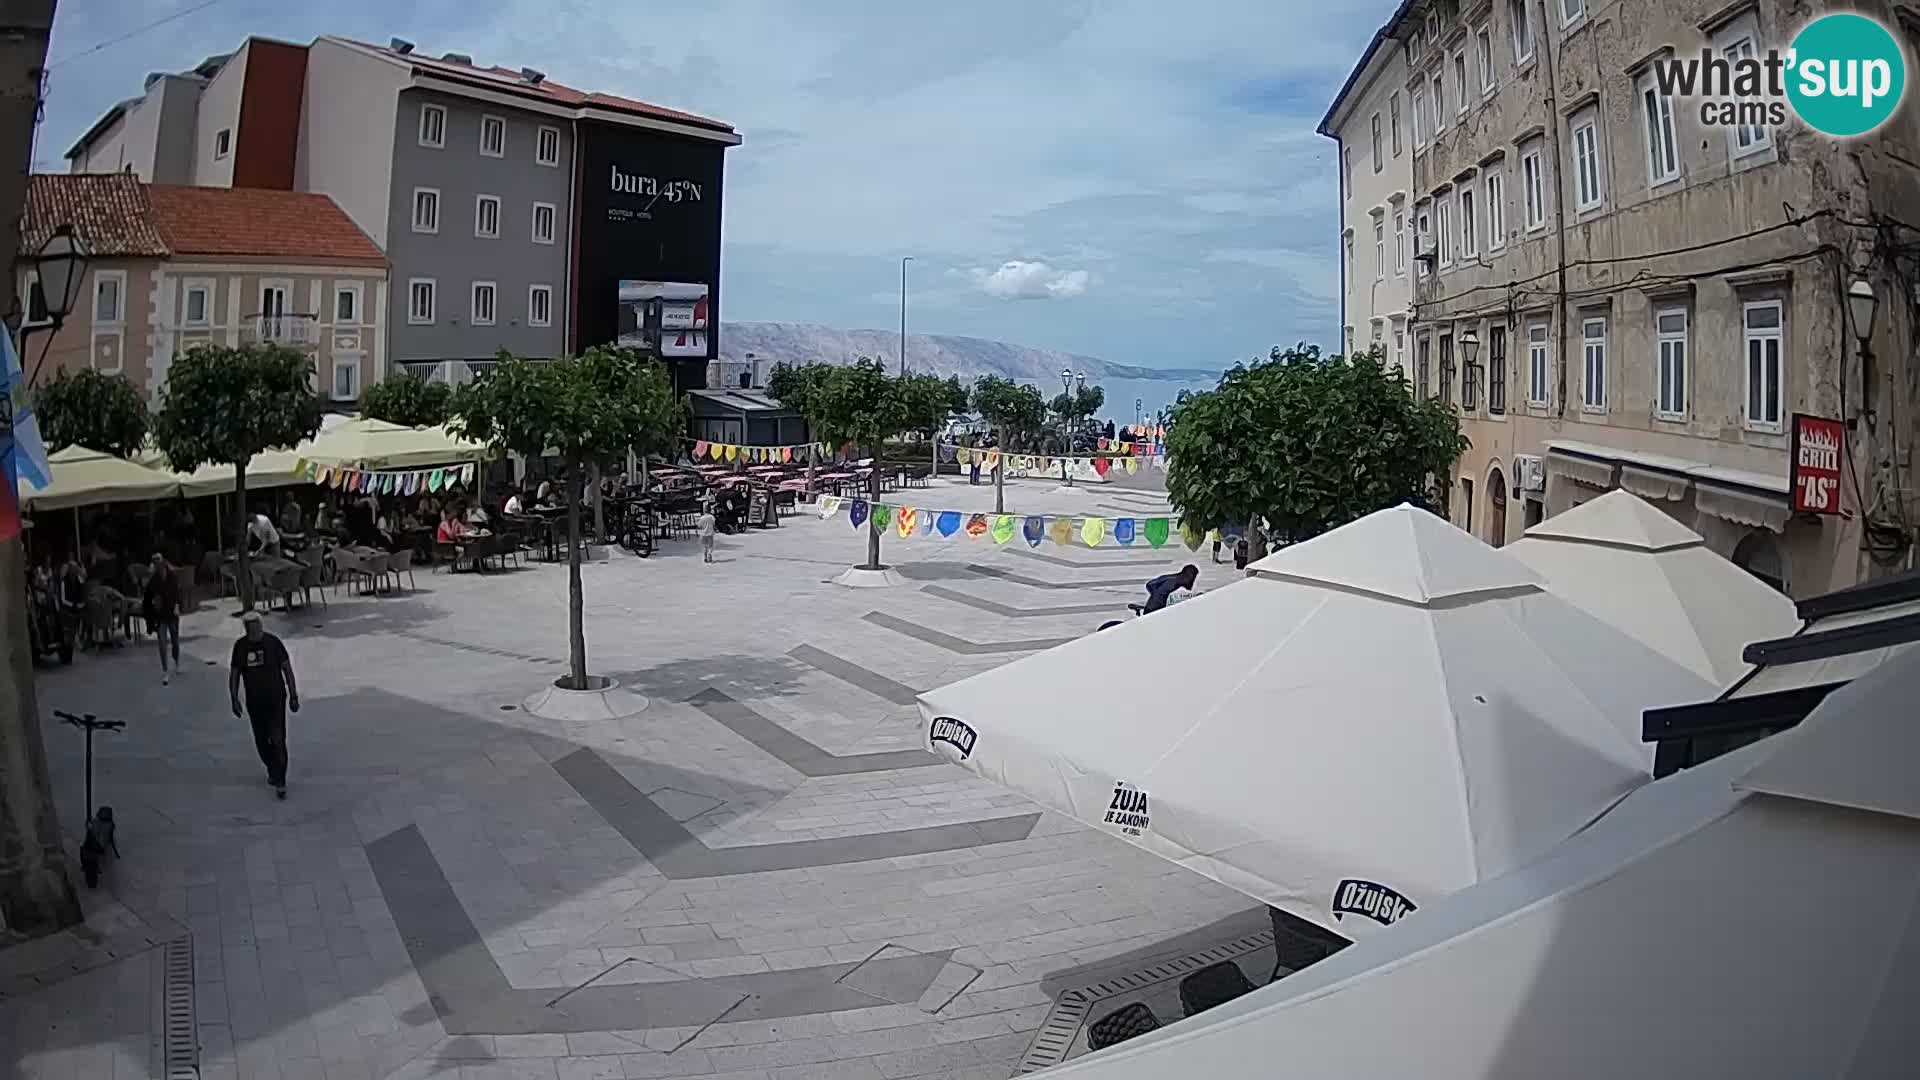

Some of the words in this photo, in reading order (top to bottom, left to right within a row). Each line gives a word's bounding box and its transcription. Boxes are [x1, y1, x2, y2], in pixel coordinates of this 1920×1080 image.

[611, 165, 657, 196] bura
[1799, 447, 1838, 471] GRILL
[932, 719, 973, 750] Ožujsko
[1109, 781, 1147, 815] ŽUJA
[1103, 810, 1115, 823] JE
[1340, 882, 1408, 923] Ožujsk
